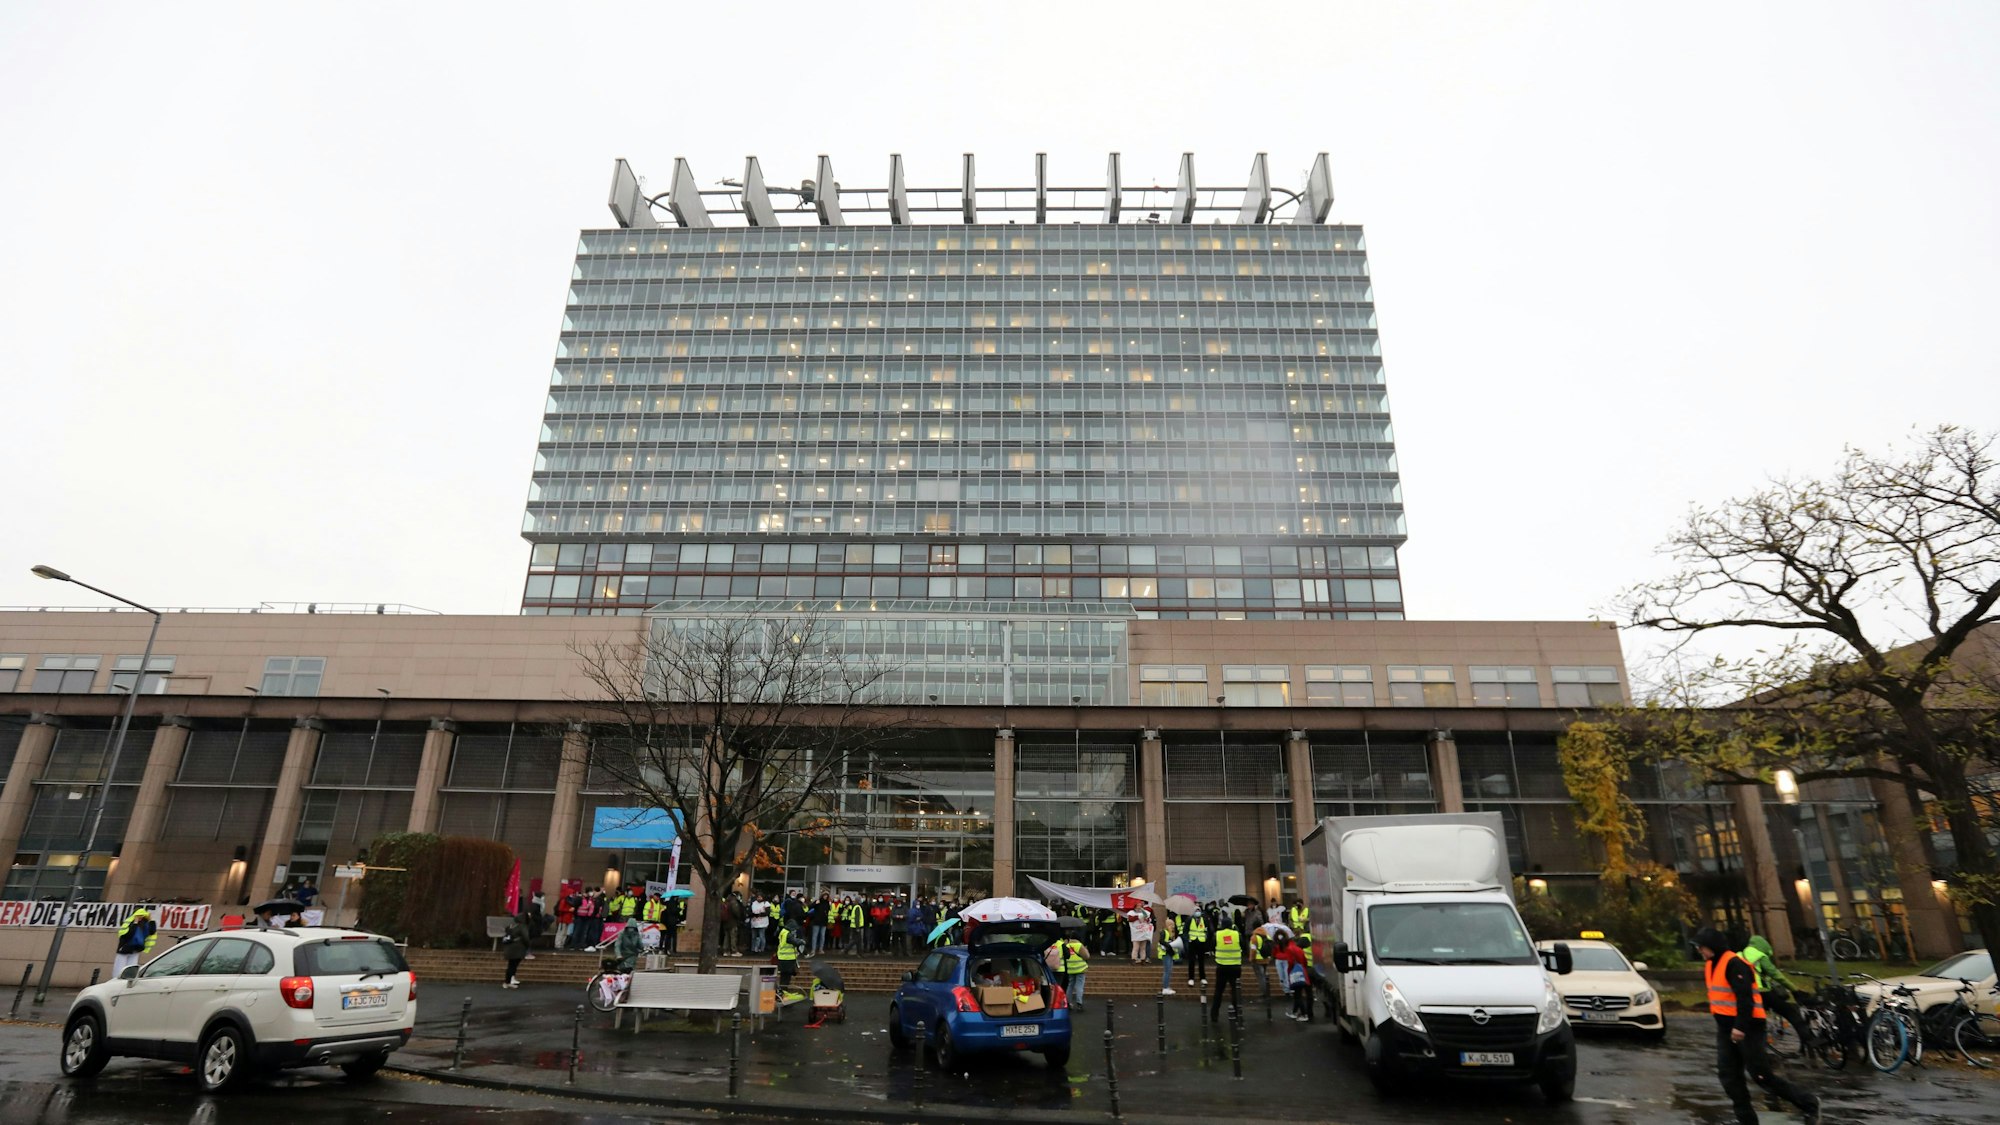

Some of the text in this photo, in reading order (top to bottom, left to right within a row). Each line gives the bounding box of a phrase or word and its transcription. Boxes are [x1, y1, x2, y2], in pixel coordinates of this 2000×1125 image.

[0, 902, 210, 930] ER! DIE SCHNAU VOLL!
[359, 996, 368, 1004] JC
[368, 995, 386, 1004] 7074
[1024, 1025, 1036, 1034] 252
[1493, 1053, 1510, 1063] 510
